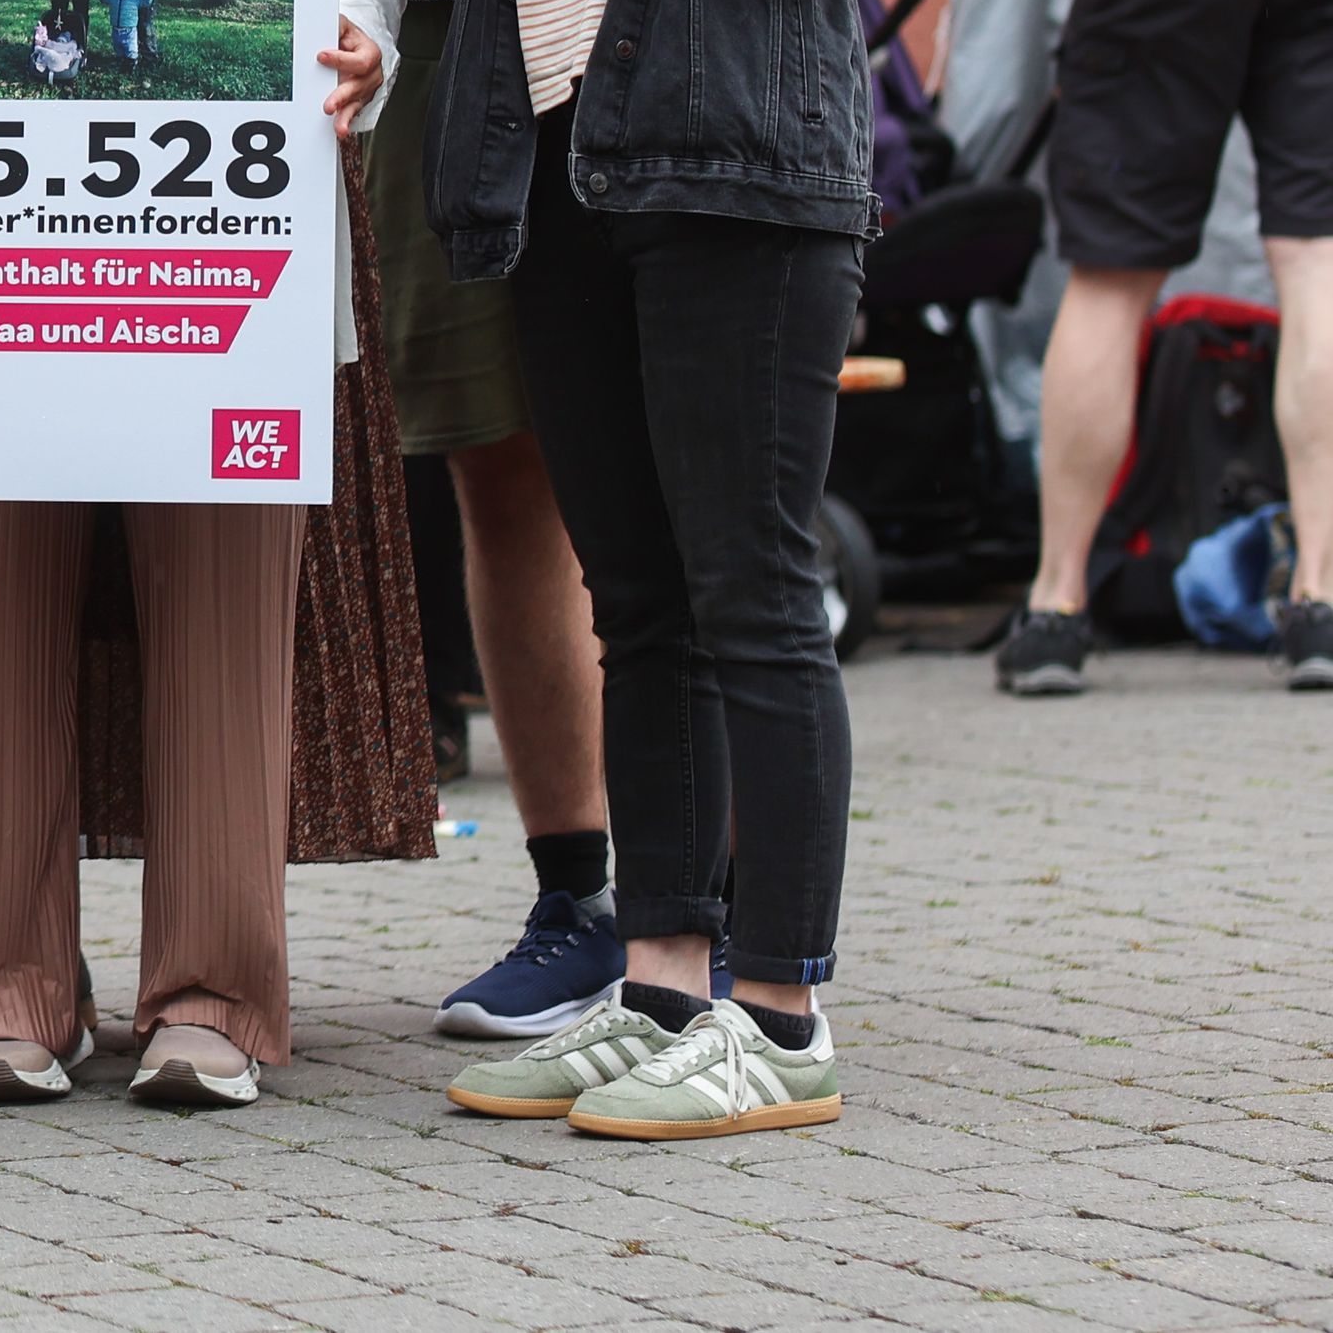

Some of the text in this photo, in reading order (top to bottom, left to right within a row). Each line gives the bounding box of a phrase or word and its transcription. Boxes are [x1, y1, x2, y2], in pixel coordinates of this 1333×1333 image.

[92, 258, 143, 288] für
[149, 261, 261, 292] Naima,
[41, 319, 104, 346] und
[110, 320, 221, 347] Aischa
[230, 419, 280, 445] WE
